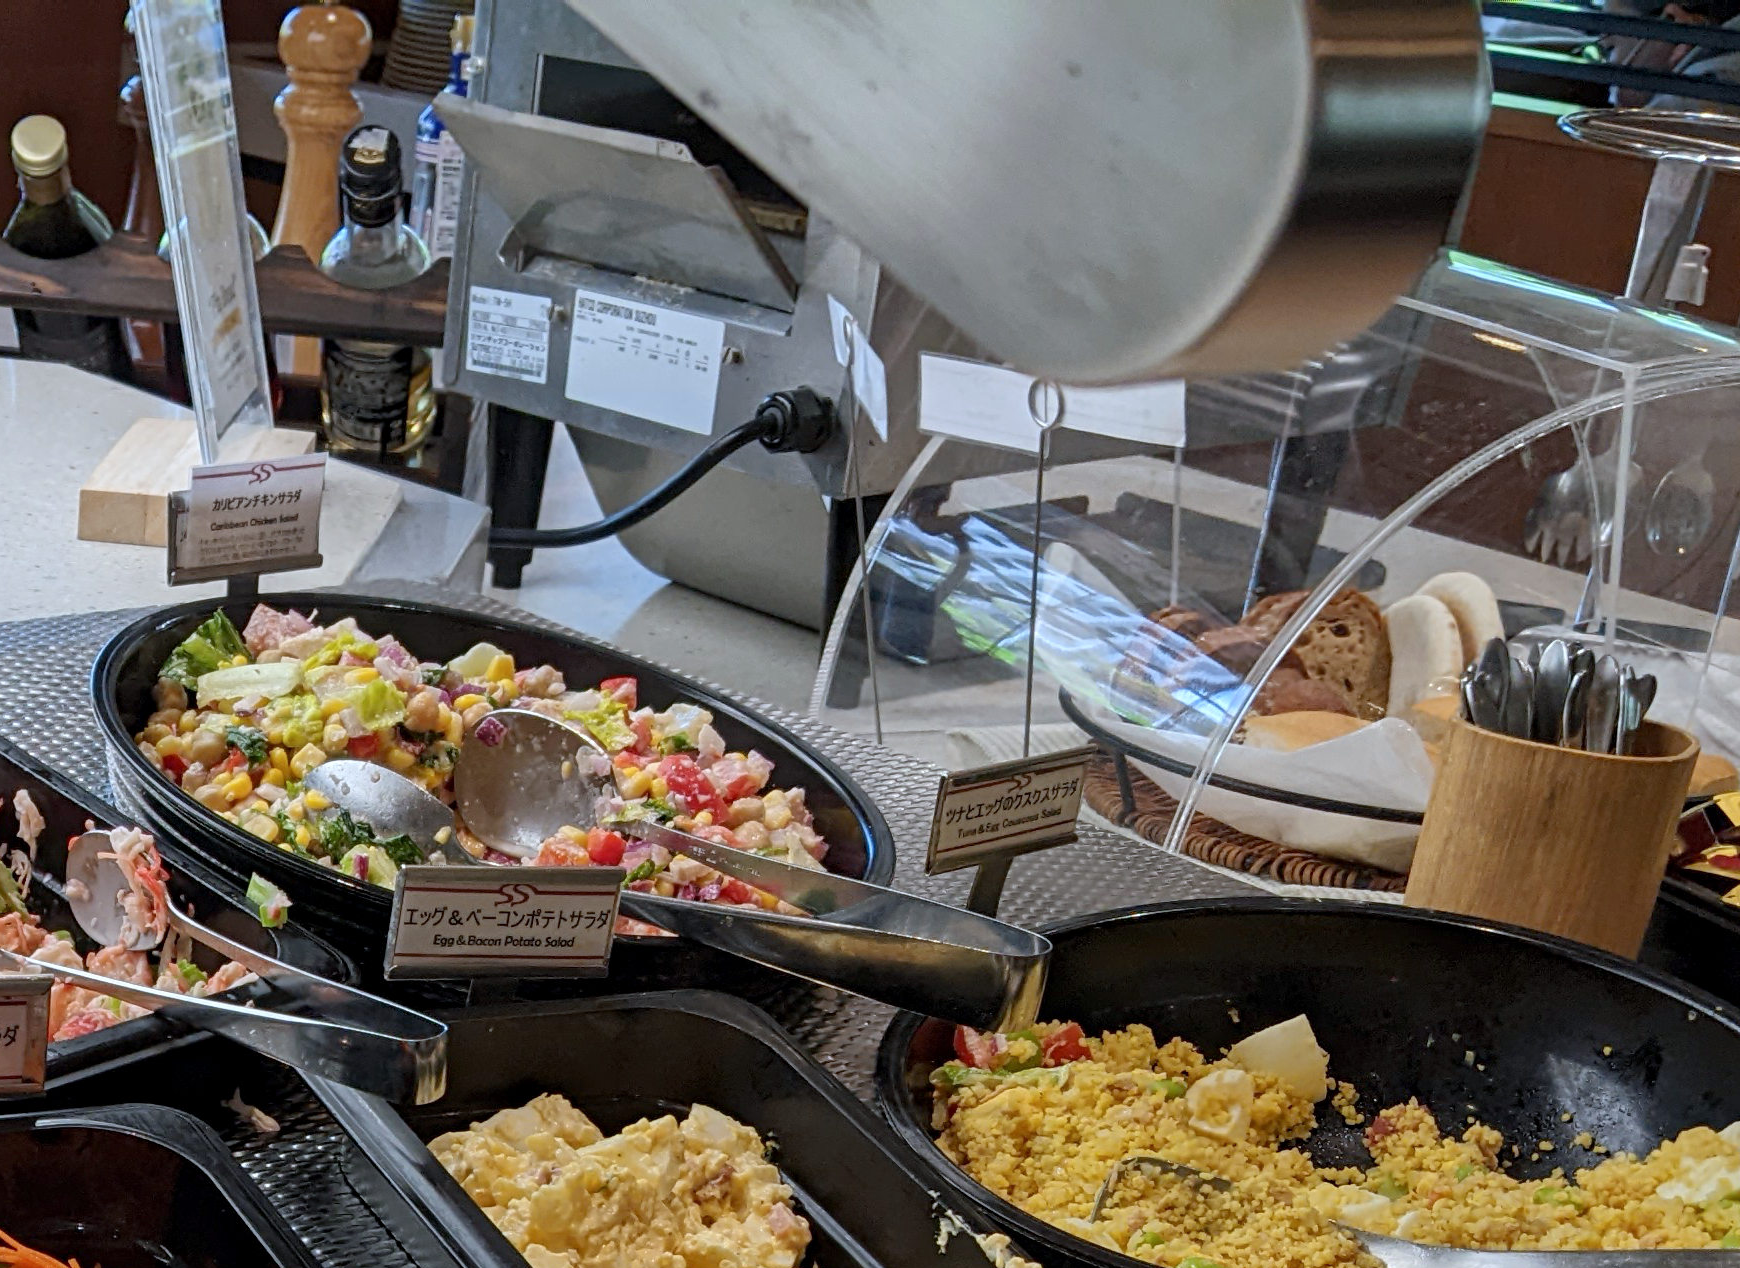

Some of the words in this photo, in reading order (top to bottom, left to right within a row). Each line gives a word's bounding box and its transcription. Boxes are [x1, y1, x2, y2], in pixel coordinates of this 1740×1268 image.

[946, 778, 1080, 825] ツナとエッグのクスクスサラダ
[504, 936, 542, 947] Potato
[545, 936, 576, 947] Salad
